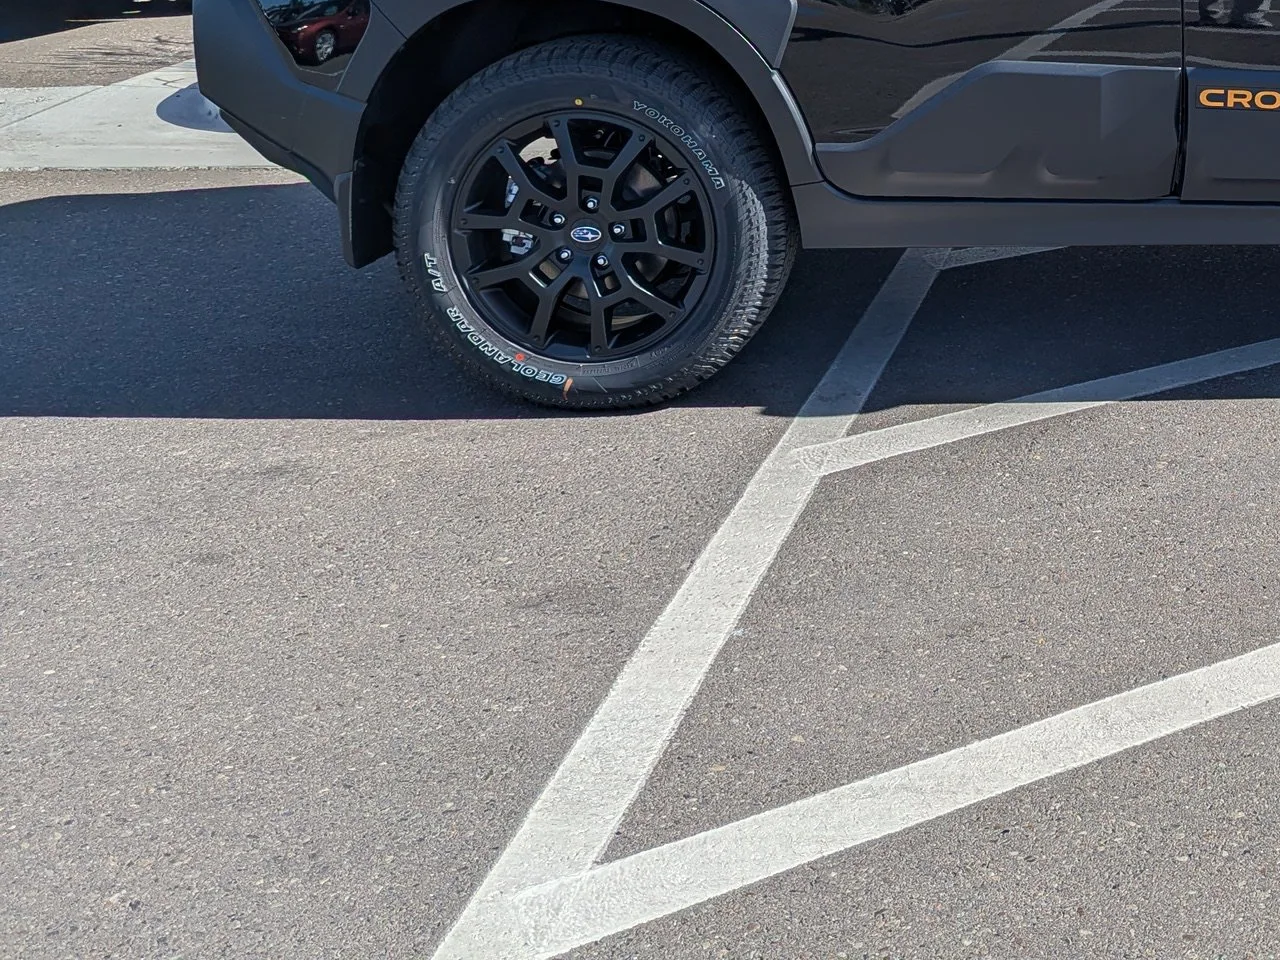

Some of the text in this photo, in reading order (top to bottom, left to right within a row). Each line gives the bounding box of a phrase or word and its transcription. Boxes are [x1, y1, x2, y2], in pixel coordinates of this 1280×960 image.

[633, 100, 725, 189] YOKOHAMA
[424, 252, 568, 385] GEOLANDAR A/T
